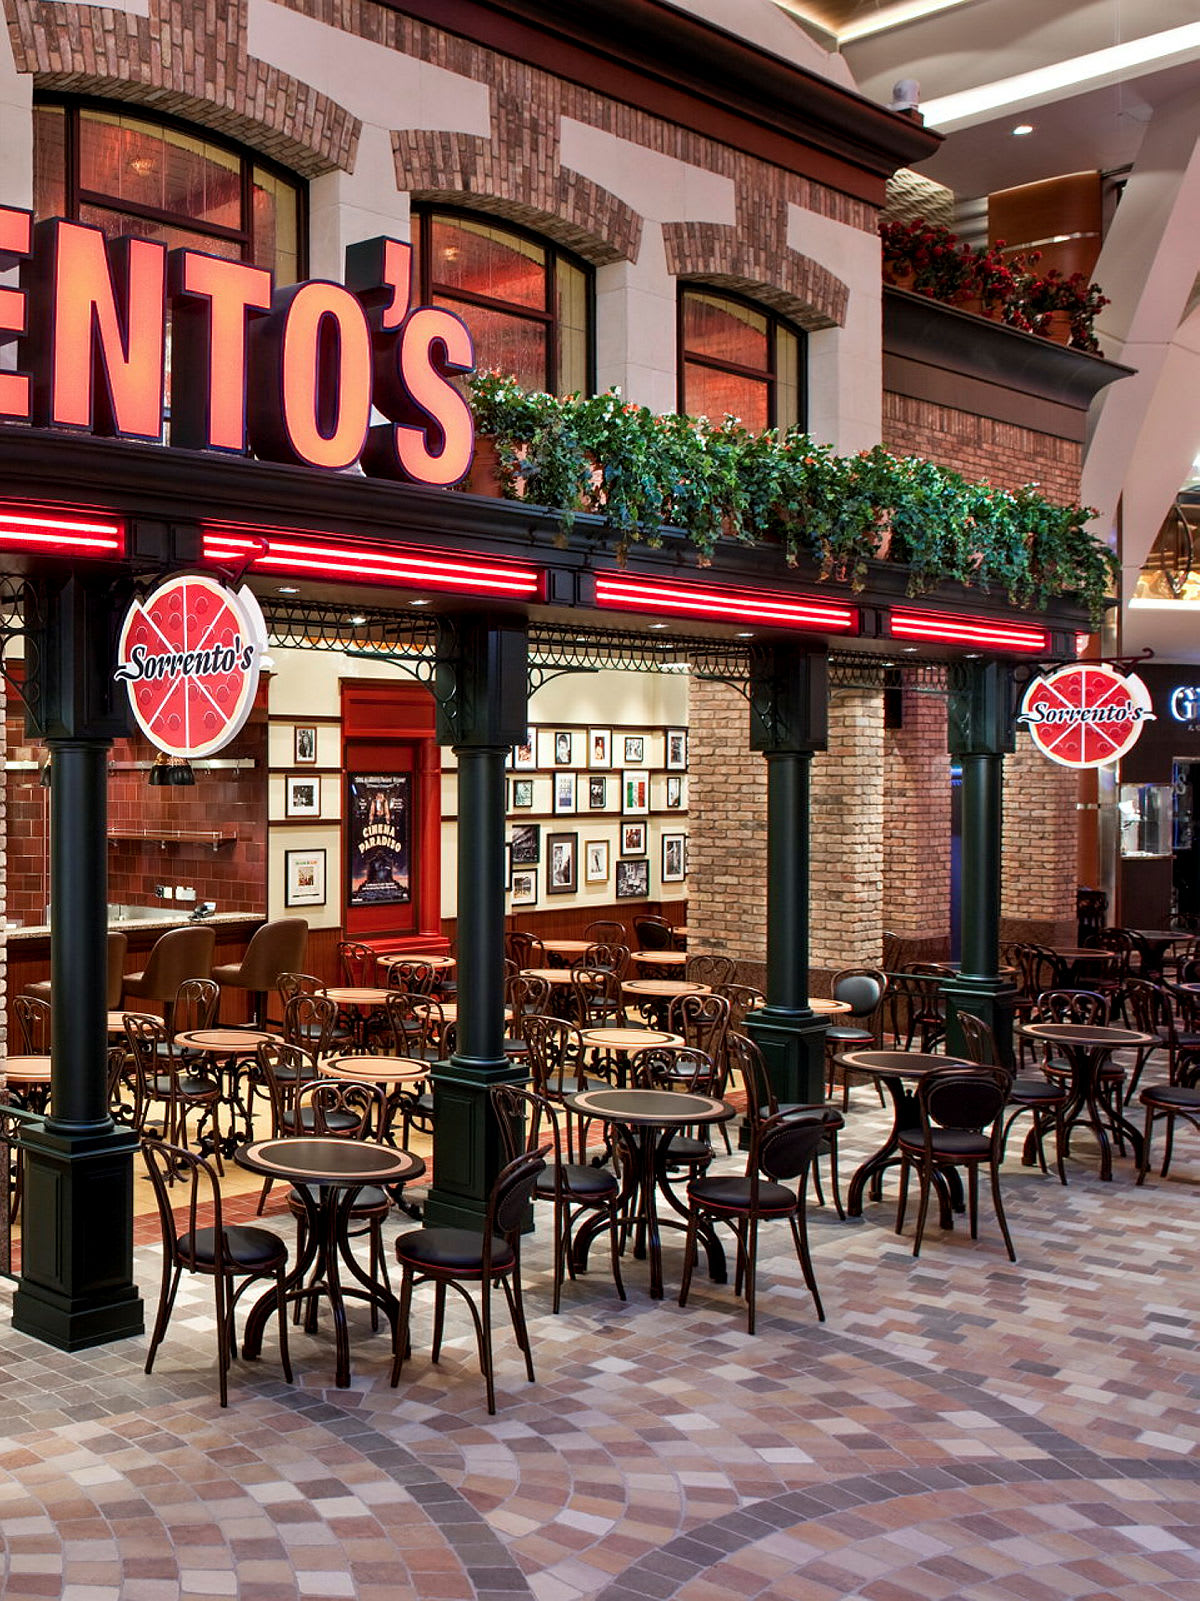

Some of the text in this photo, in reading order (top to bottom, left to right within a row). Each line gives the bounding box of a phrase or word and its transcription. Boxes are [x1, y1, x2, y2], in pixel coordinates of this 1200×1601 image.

[114, 635, 254, 680] Sorrento's
[1017, 700, 1145, 723] Sorrento's
[1171, 686, 1200, 721] G
[362, 823, 396, 838] CINEMA
[358, 835, 402, 854] PARADISO
